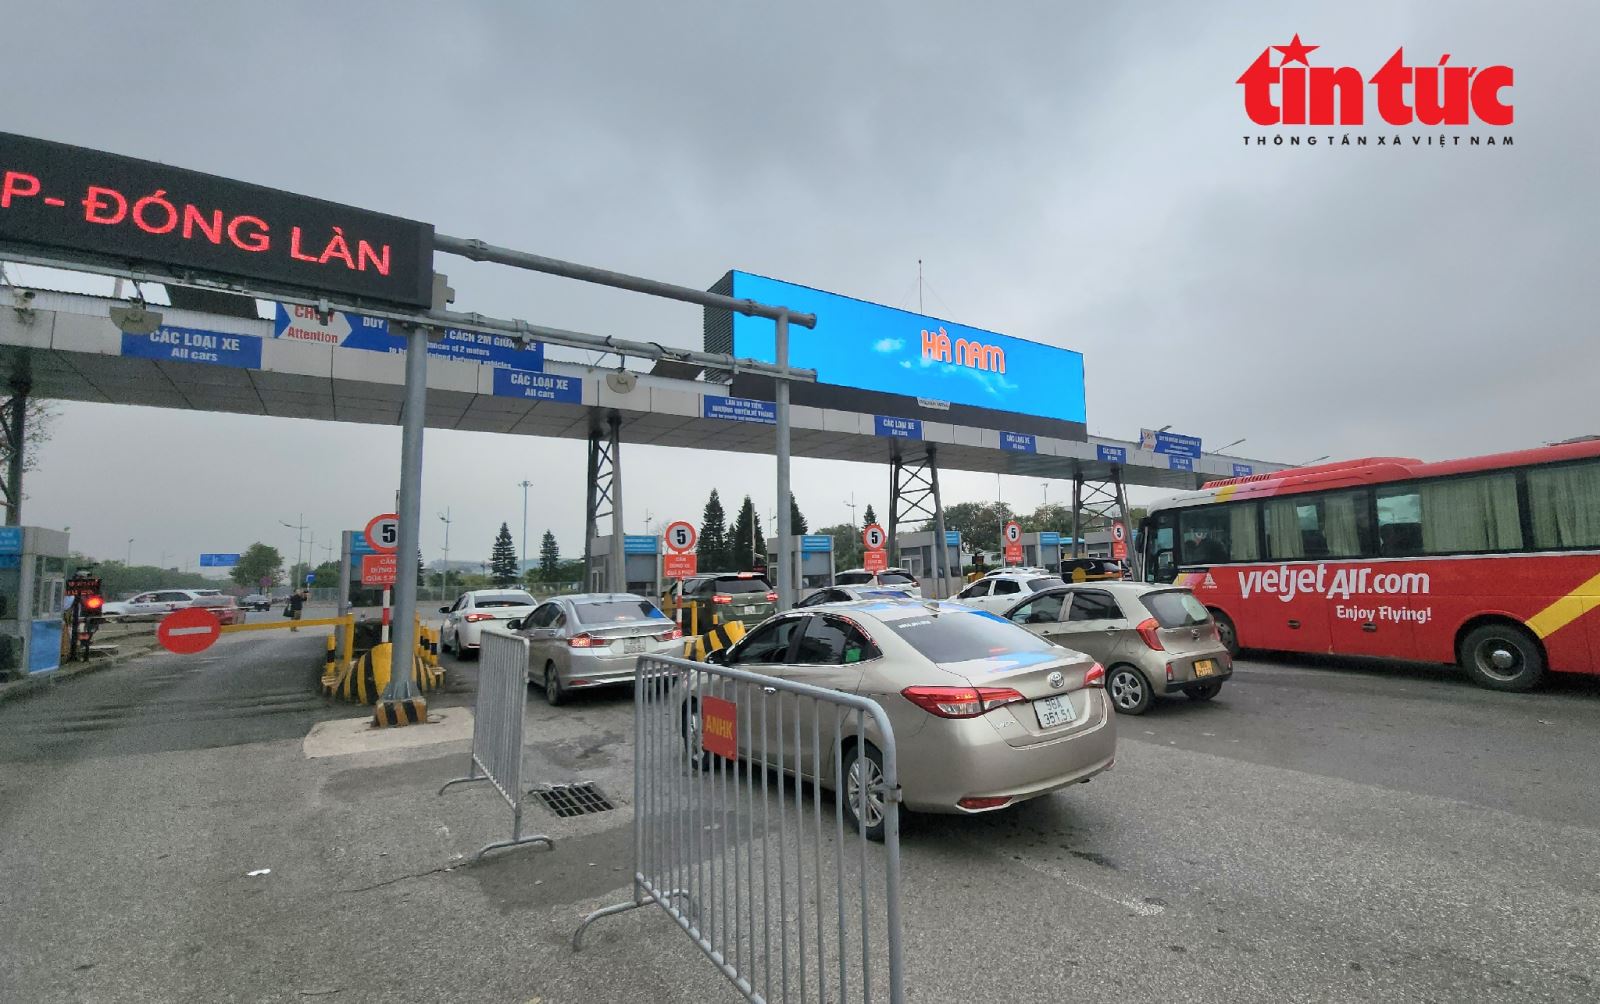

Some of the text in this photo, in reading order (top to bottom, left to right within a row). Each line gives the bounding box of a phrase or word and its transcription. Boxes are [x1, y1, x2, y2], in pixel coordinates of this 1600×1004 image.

[82, 185, 271, 252] ĐÓNG
[290, 226, 391, 276] LÀN
[362, 316, 384, 329] DUY
[150, 327, 240, 352] CÁC LOẠI XE
[287, 326, 338, 343] Attention
[477, 334, 491, 345] 2M
[921, 326, 952, 363] HÀ
[171, 348, 218, 362] All cars
[511, 372, 569, 390] CÁC LOẠI XE
[525, 388, 536, 397] All
[382, 524, 396, 543] 5
[676, 529, 687, 545] 5
[871, 531, 878, 544] 5
[1011, 527, 1016, 539] 5
[1116, 527, 1122, 538] 5
[1336, 605, 1432, 624] Enjoy Flying!
[705, 714, 734, 741] ANHK
